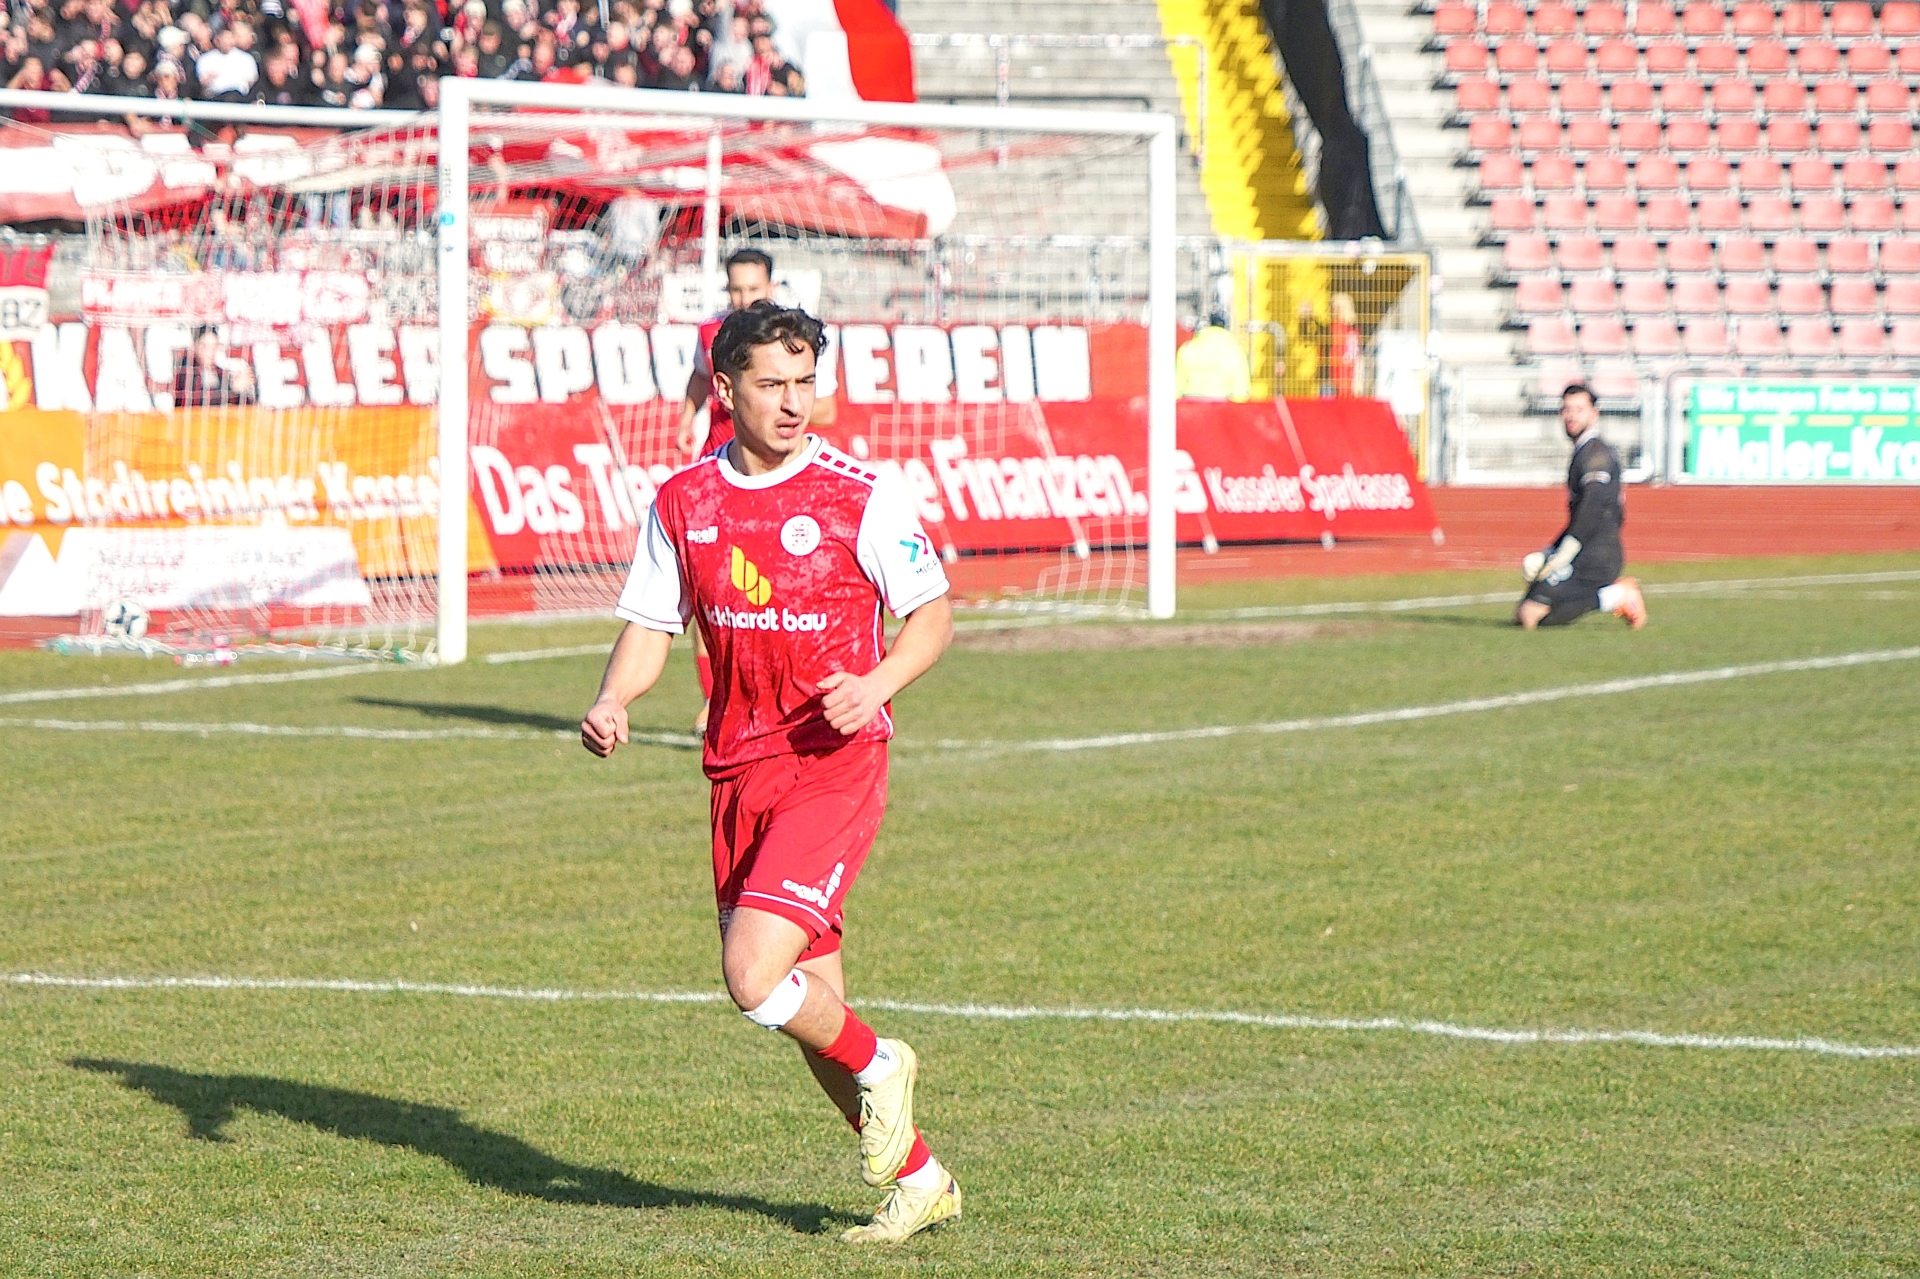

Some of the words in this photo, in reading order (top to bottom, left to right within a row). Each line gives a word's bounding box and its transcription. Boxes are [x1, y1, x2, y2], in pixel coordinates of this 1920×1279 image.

[468, 443, 584, 534] Das
[929, 433, 1149, 521] Finanzen.
[1203, 464, 1306, 513] Kasseler
[1299, 461, 1415, 521] Sparkasse
[782, 606, 827, 633] bau
